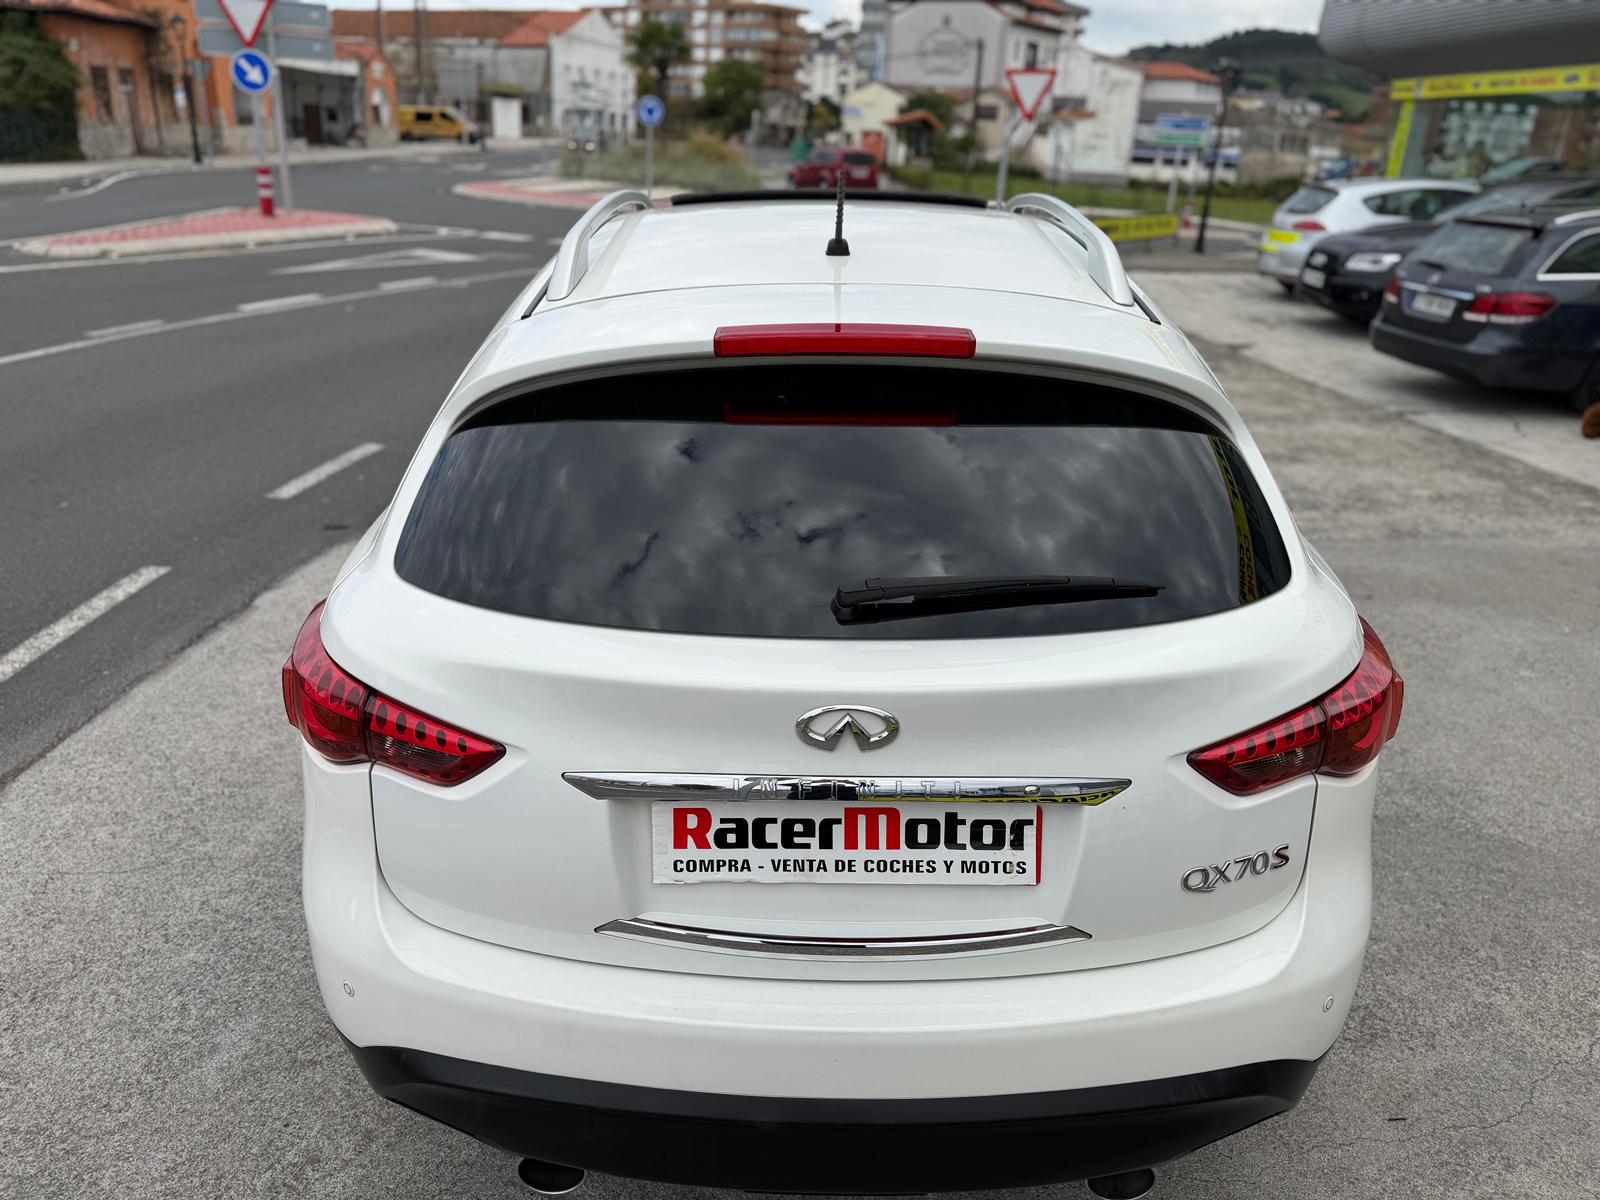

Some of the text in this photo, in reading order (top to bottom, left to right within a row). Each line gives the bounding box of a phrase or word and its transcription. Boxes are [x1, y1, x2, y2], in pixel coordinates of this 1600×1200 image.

[732, 778, 961, 800] INFINITI
[672, 807, 1034, 851] RacerMotor
[672, 859, 752, 873] COMPRA
[770, 859, 828, 873] VENTA
[834, 859, 857, 873] DE
[863, 859, 937, 873] COCHES
[943, 860, 954, 874] Y
[960, 860, 1027, 875] MOTOS
